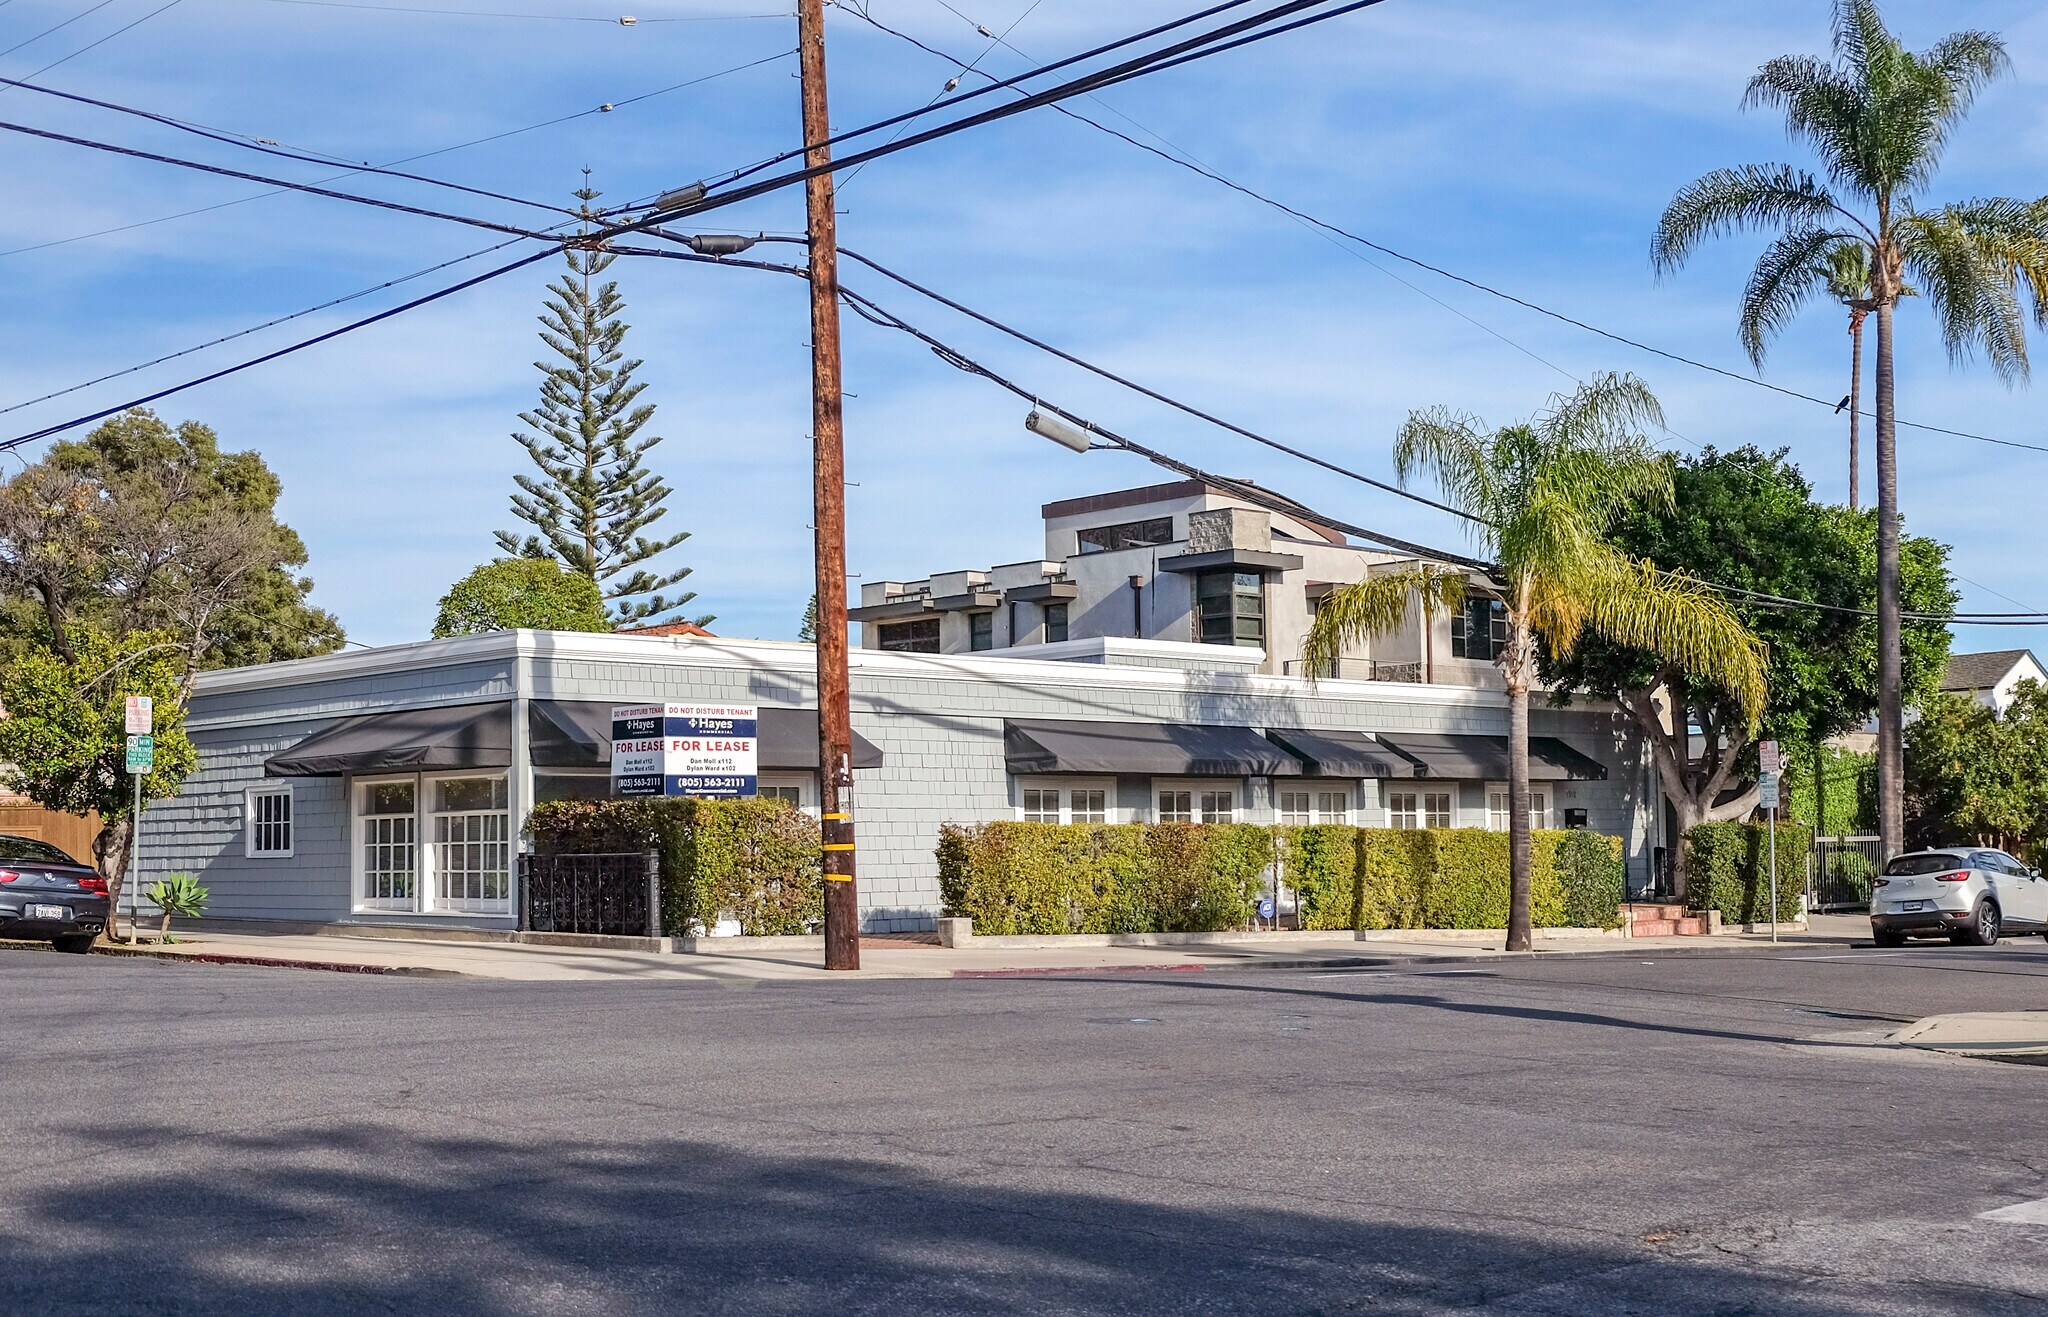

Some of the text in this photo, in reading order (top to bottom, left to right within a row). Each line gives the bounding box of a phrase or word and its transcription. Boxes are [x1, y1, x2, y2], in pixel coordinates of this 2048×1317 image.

[621, 709, 630, 717] NOT
[630, 708, 648, 716] DISTURB
[649, 706, 664, 714] TENAN
[669, 706, 753, 716] DO NOT DISTURB TENANT
[632, 719, 655, 731] Hayes
[699, 718, 733, 731] Hayes
[128, 737, 138, 746] 90
[615, 741, 664, 753] FOR LEASE
[673, 740, 750, 752] FOR LEASE
[617, 777, 660, 788] (805) 563-2111
[678, 777, 745, 788] (805) 563-2111
